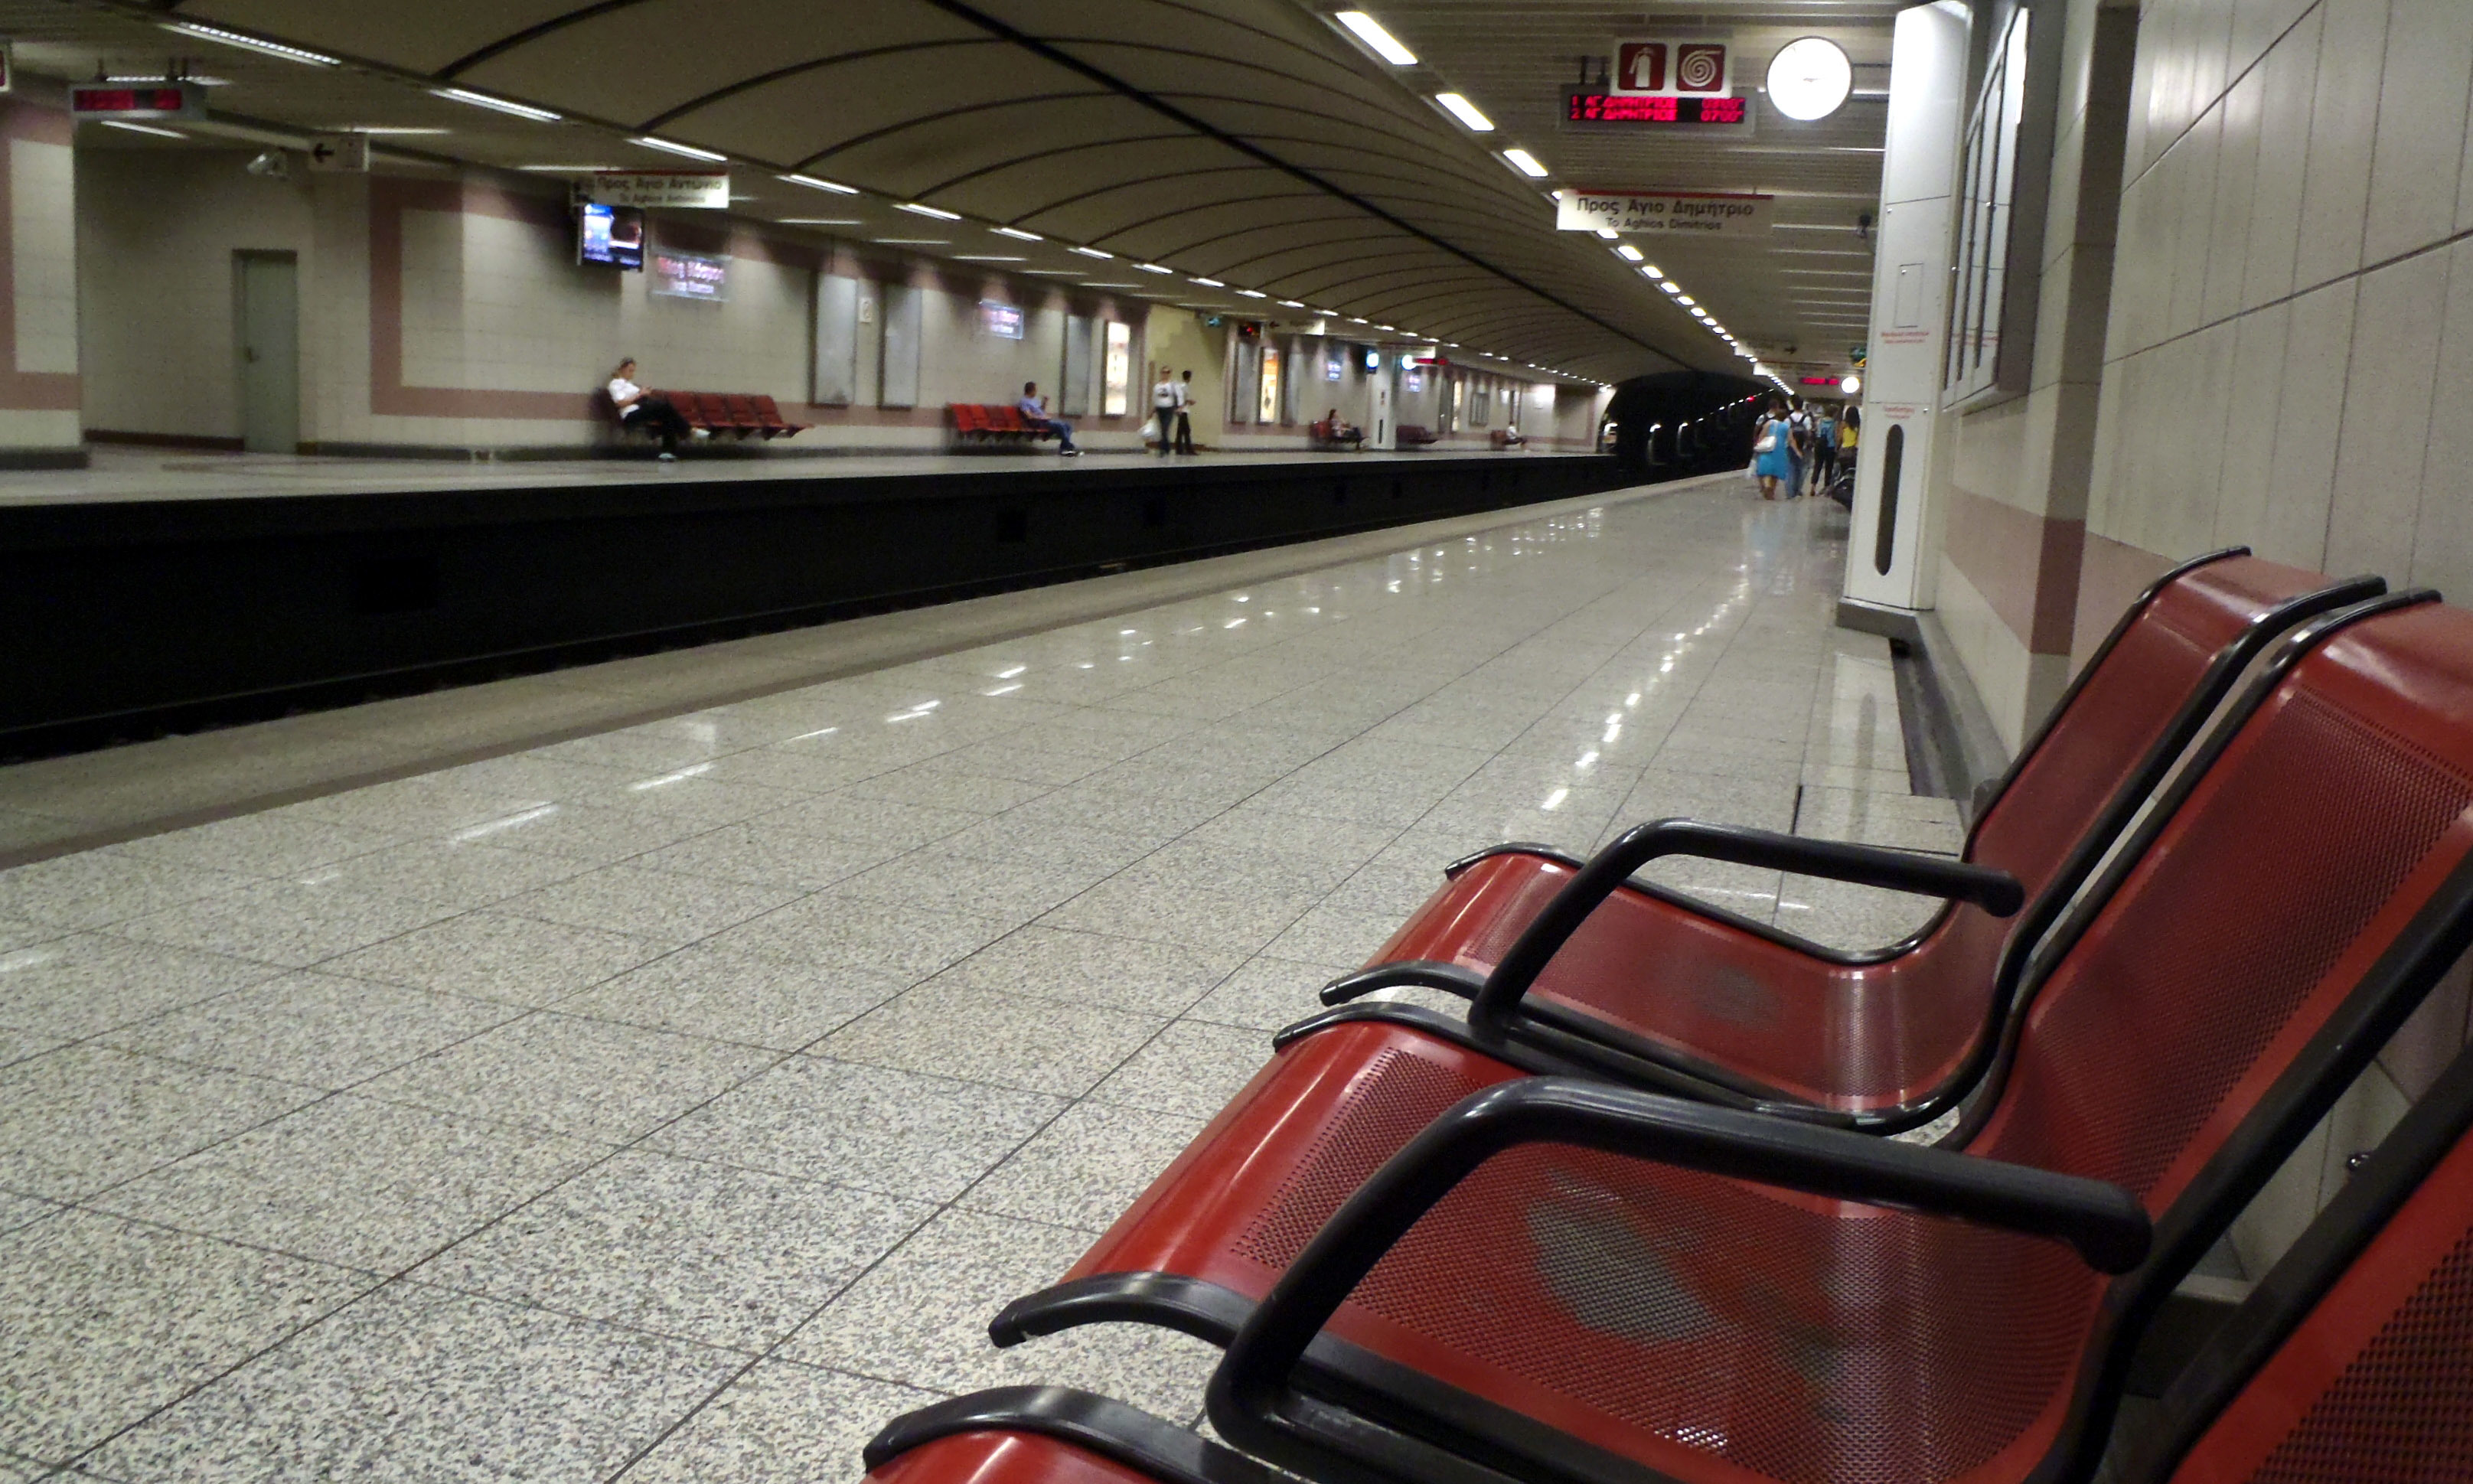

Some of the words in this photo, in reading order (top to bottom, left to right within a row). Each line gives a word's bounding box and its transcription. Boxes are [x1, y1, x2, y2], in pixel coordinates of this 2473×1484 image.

[1577, 197, 1620, 215] Προς
[1672, 200, 1754, 218] Δημήτριο
[1605, 217, 1620, 227] To
